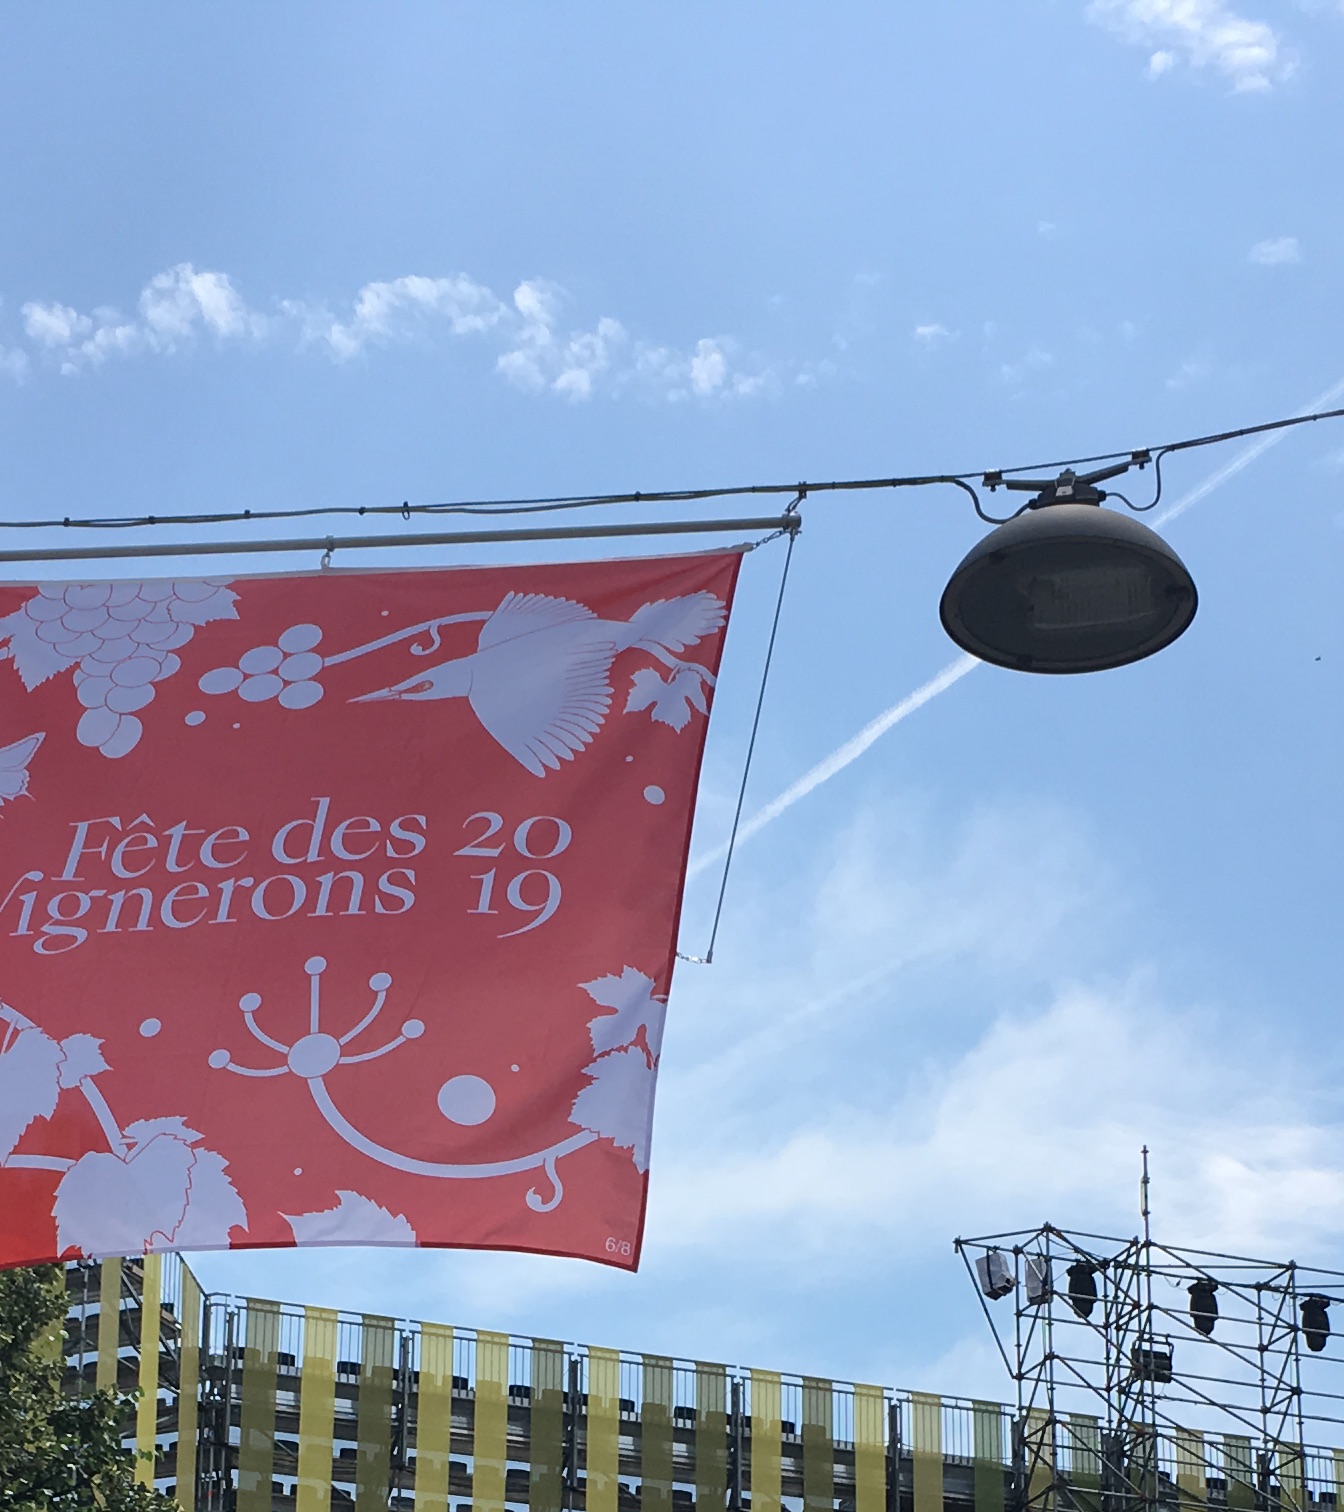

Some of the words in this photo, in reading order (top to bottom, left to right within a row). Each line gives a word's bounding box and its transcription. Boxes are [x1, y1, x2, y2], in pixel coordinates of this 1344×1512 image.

[51, 813, 250, 881] Fête
[271, 797, 427, 864] des
[453, 811, 572, 859] 20
[467, 867, 562, 939] 19
[605, 1236, 631, 1256] 6/8
